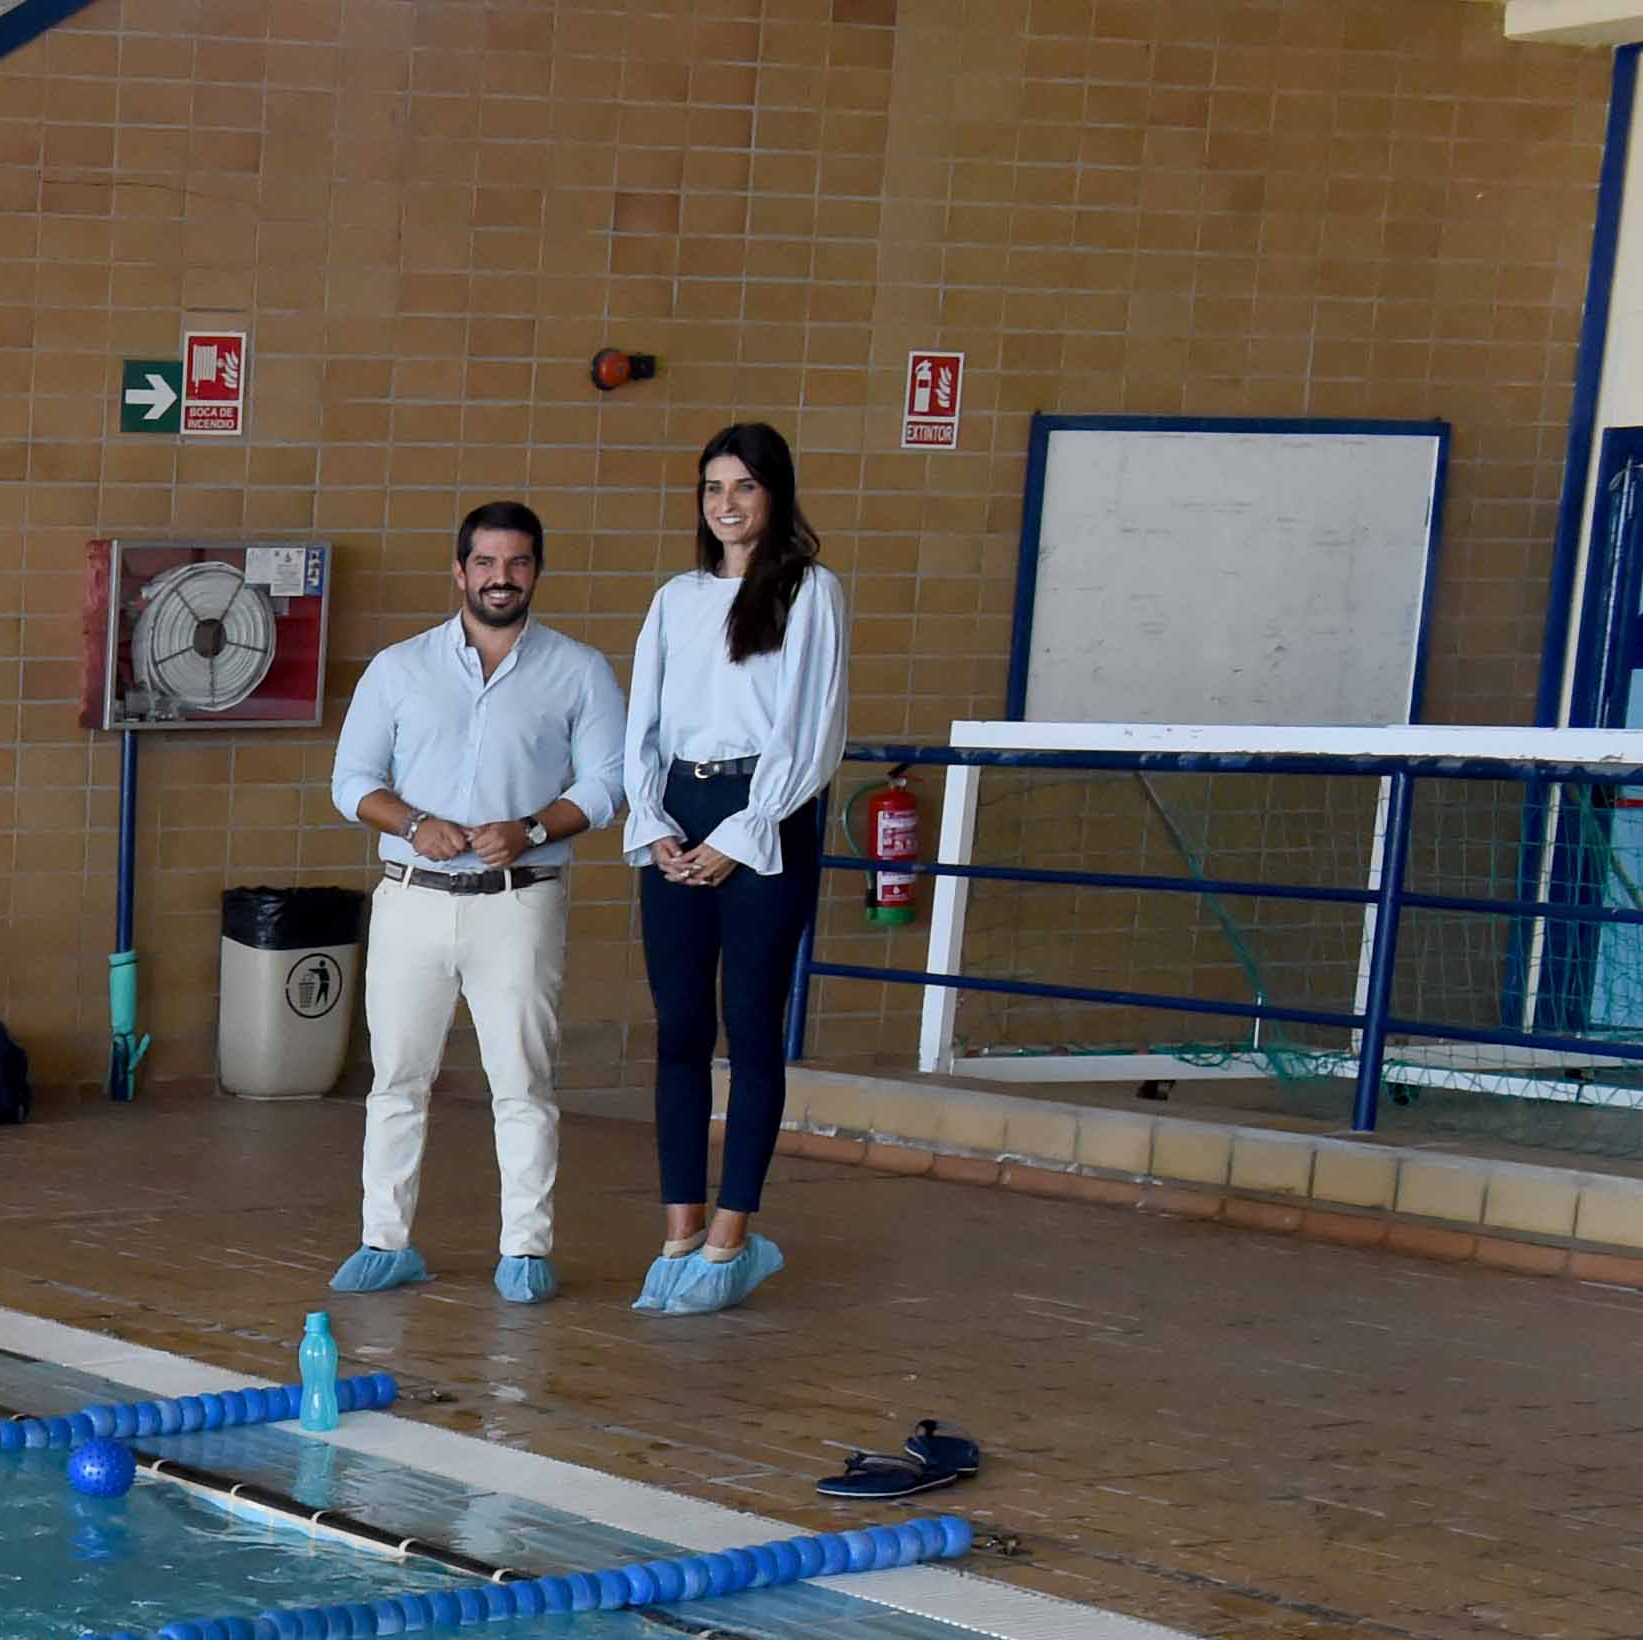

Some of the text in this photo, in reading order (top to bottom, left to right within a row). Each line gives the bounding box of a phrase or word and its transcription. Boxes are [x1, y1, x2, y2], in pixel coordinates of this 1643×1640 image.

[189, 407, 235, 418] BOCA DE
[187, 418, 235, 429] INCENDIO
[906, 424, 953, 441] EXTINTOR
